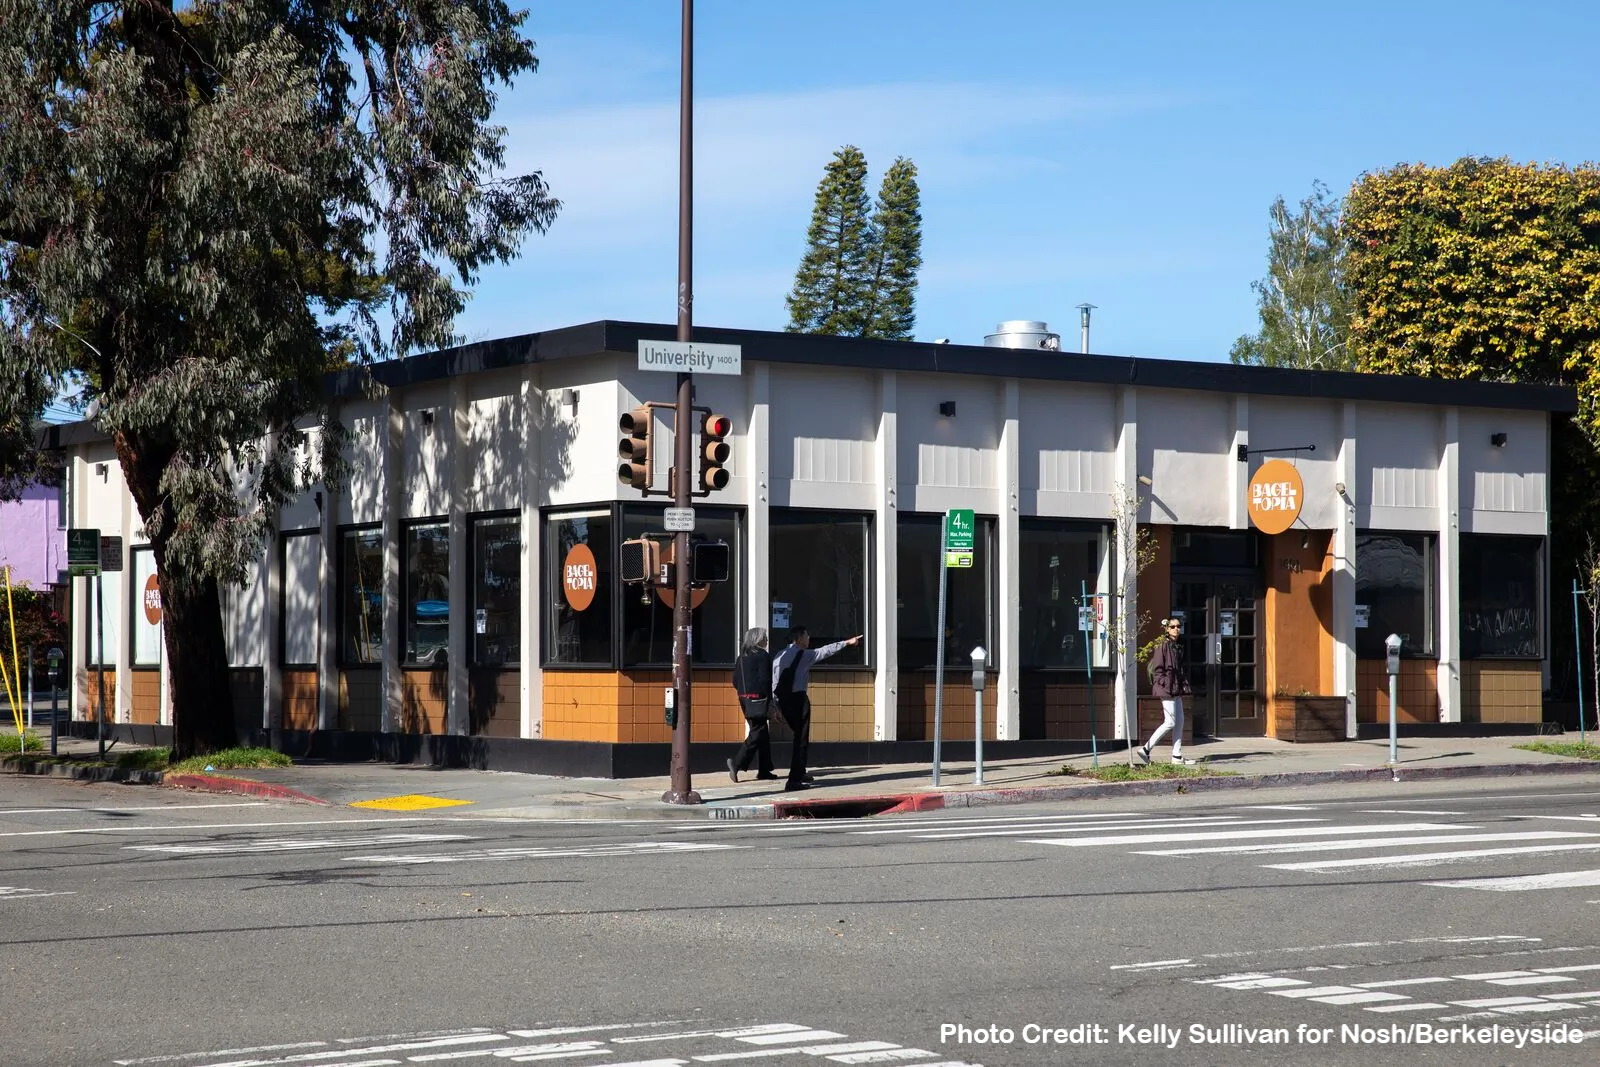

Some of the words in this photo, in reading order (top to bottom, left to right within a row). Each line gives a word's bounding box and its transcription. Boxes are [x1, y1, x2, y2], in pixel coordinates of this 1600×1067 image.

[645, 347, 714, 369] University
[717, 356, 732, 364] 1400
[1253, 482, 1296, 497] BAGEL
[1253, 497, 1296, 511] TOPIA
[953, 513, 961, 529] 4
[72, 532, 81, 545] 4
[567, 565, 593, 577] BAGEL
[567, 577, 593, 590] TOPIA
